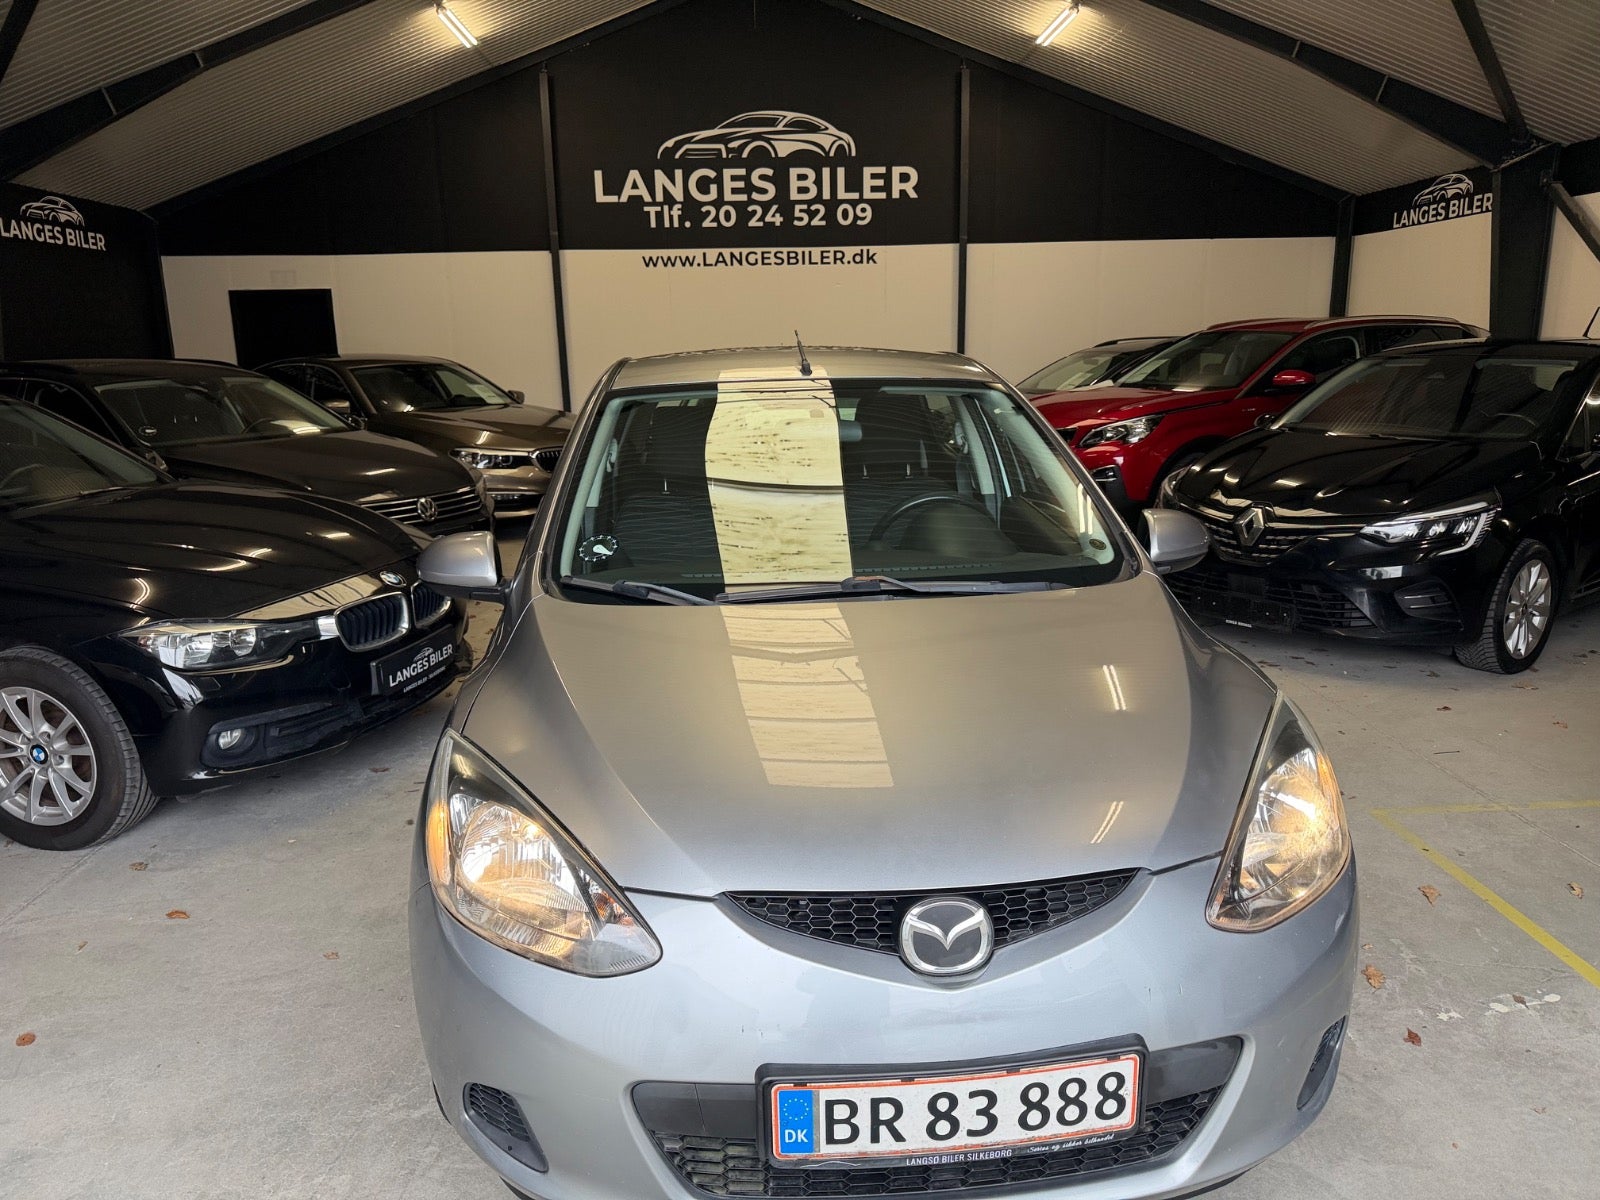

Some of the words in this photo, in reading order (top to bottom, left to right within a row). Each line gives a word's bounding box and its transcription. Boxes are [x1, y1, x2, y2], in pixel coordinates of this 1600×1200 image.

[593, 167, 776, 203] LANGES
[788, 165, 919, 200] BILER
[643, 203, 691, 228] Tlf.
[701, 205, 736, 228] 20
[747, 205, 783, 228] 24
[793, 204, 826, 227] 52
[837, 203, 873, 226] 09
[1393, 201, 1446, 229] LANGES
[1448, 192, 1493, 218] BILER
[0, 217, 64, 245] LANGES
[65, 228, 107, 251] BILER
[642, 249, 877, 267] www.LANGESBILER.dk
[389, 657, 429, 687] LANGES
[430, 644, 453, 666] BILER
[824, 1097, 906, 1145] BR
[925, 1089, 998, 1141] 83
[1017, 1071, 1126, 1132] 888
[784, 1128, 809, 1144] DK
[941, 1153, 965, 1163] BILER
[967, 1149, 1012, 1161] SILKEBORG
